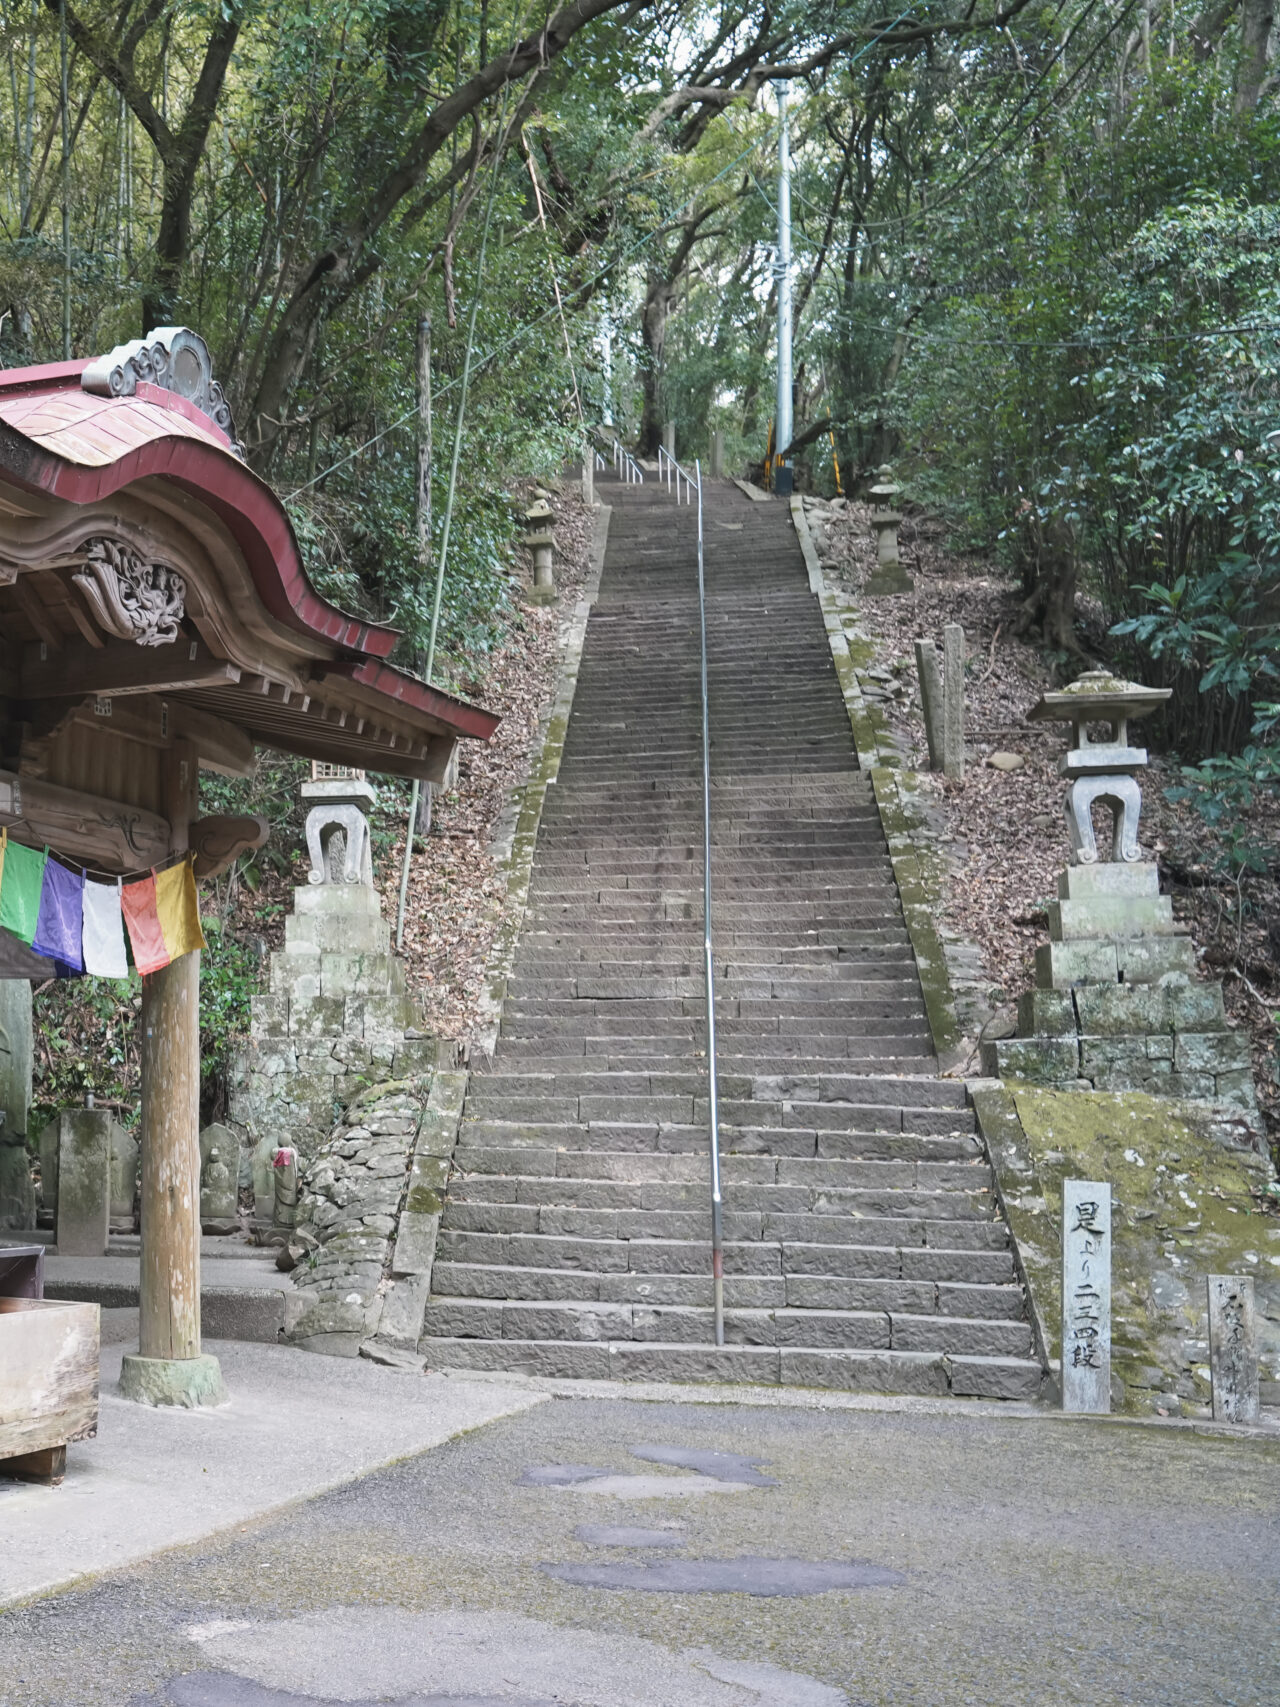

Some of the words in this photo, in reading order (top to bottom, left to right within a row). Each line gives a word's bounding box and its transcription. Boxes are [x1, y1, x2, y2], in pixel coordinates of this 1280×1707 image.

[1070, 1200, 1105, 1370] 是より二三四段
